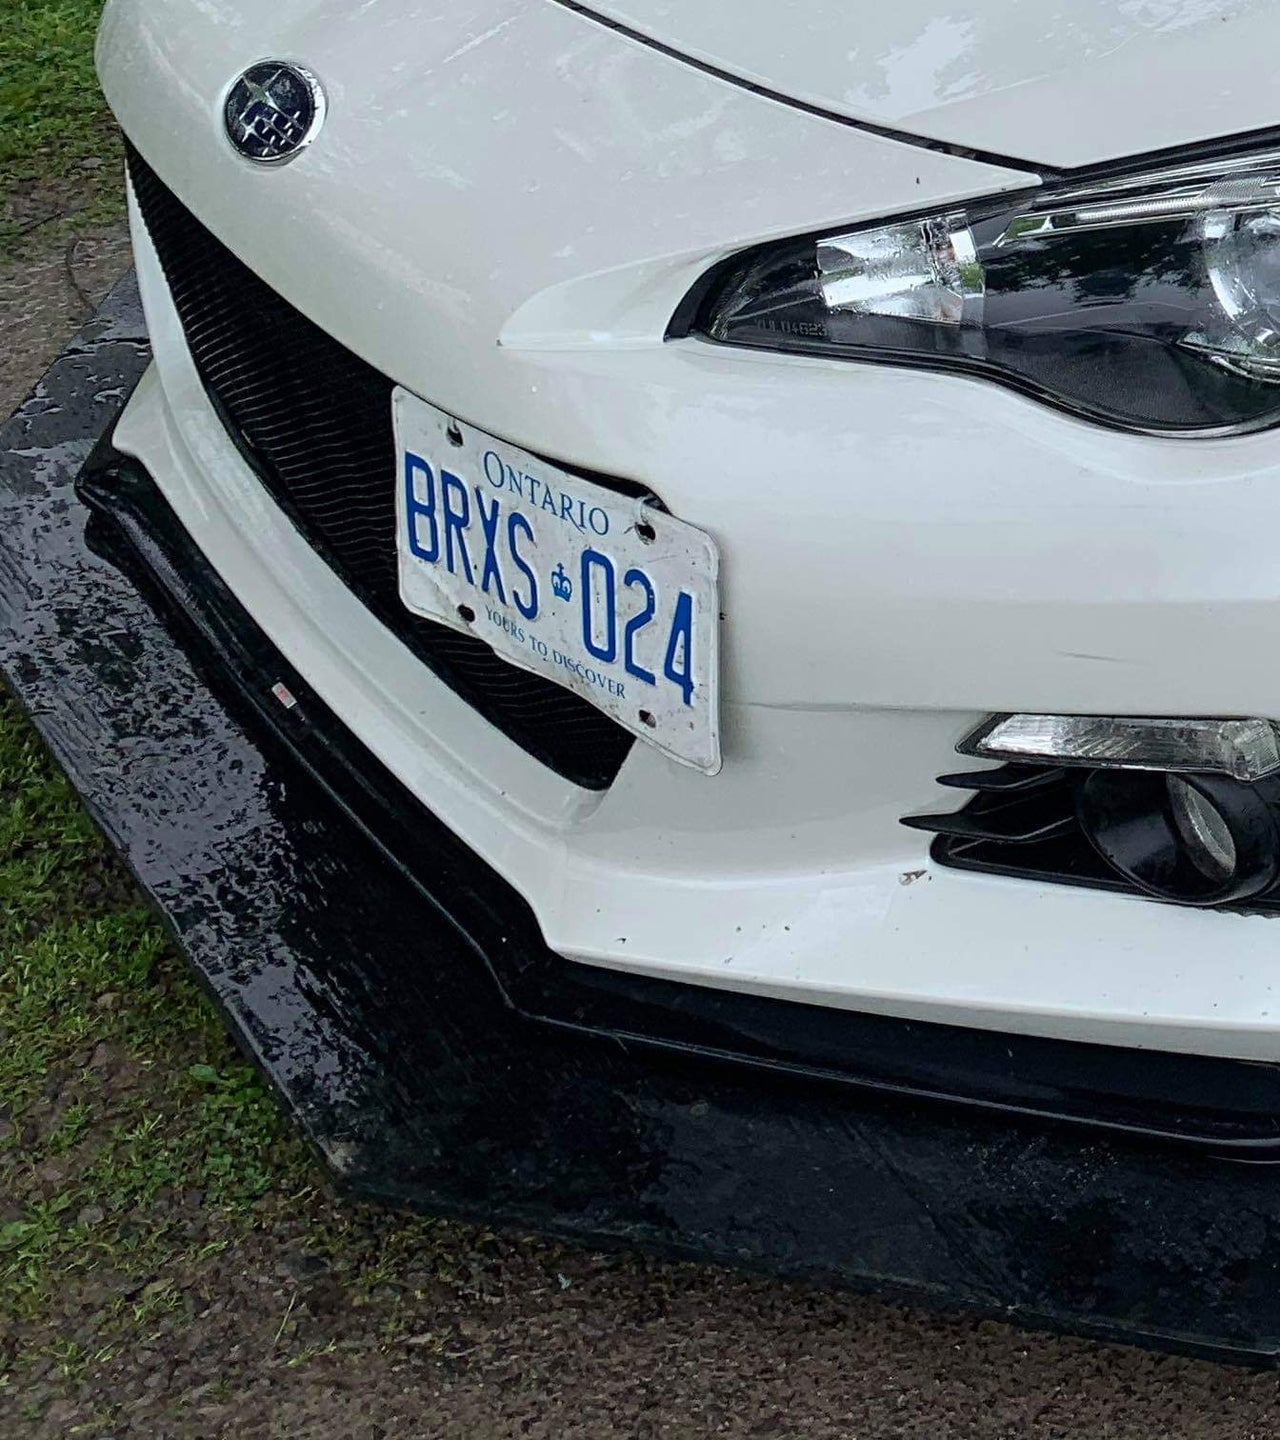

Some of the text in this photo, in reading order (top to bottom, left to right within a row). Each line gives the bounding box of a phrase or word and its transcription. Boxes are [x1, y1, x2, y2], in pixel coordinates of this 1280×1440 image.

[484, 450, 610, 536] ONTARIO
[404, 450, 693, 706] BRXS 024
[485, 605, 626, 699] YOURS TO DISCOVER
